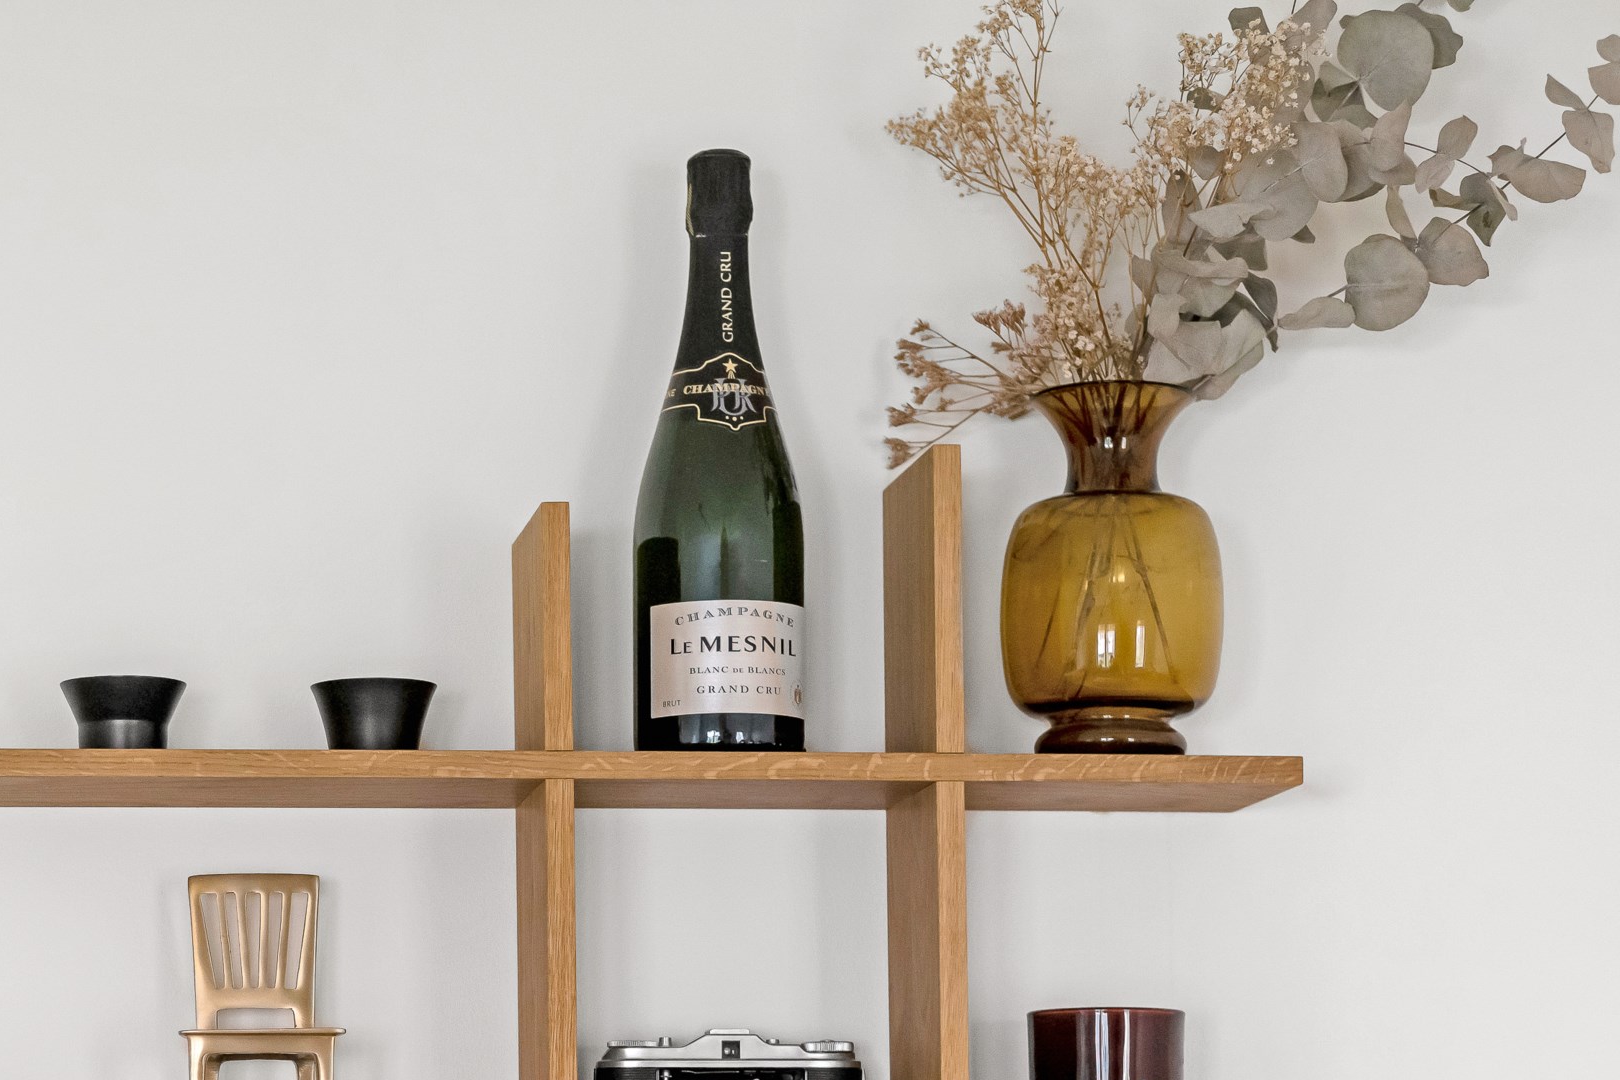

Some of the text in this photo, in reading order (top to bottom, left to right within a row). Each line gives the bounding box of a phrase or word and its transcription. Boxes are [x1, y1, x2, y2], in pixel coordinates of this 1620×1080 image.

[720, 251, 734, 343] GRAND CRU
[674, 606, 794, 628] CHAMPAGNE
[700, 635, 797, 657] MESNIL
[689, 666, 729, 675] BLANC
[747, 666, 786, 676] BLANCS
[696, 685, 781, 695] GRAND CRU
[662, 699, 681, 708] BRUT
